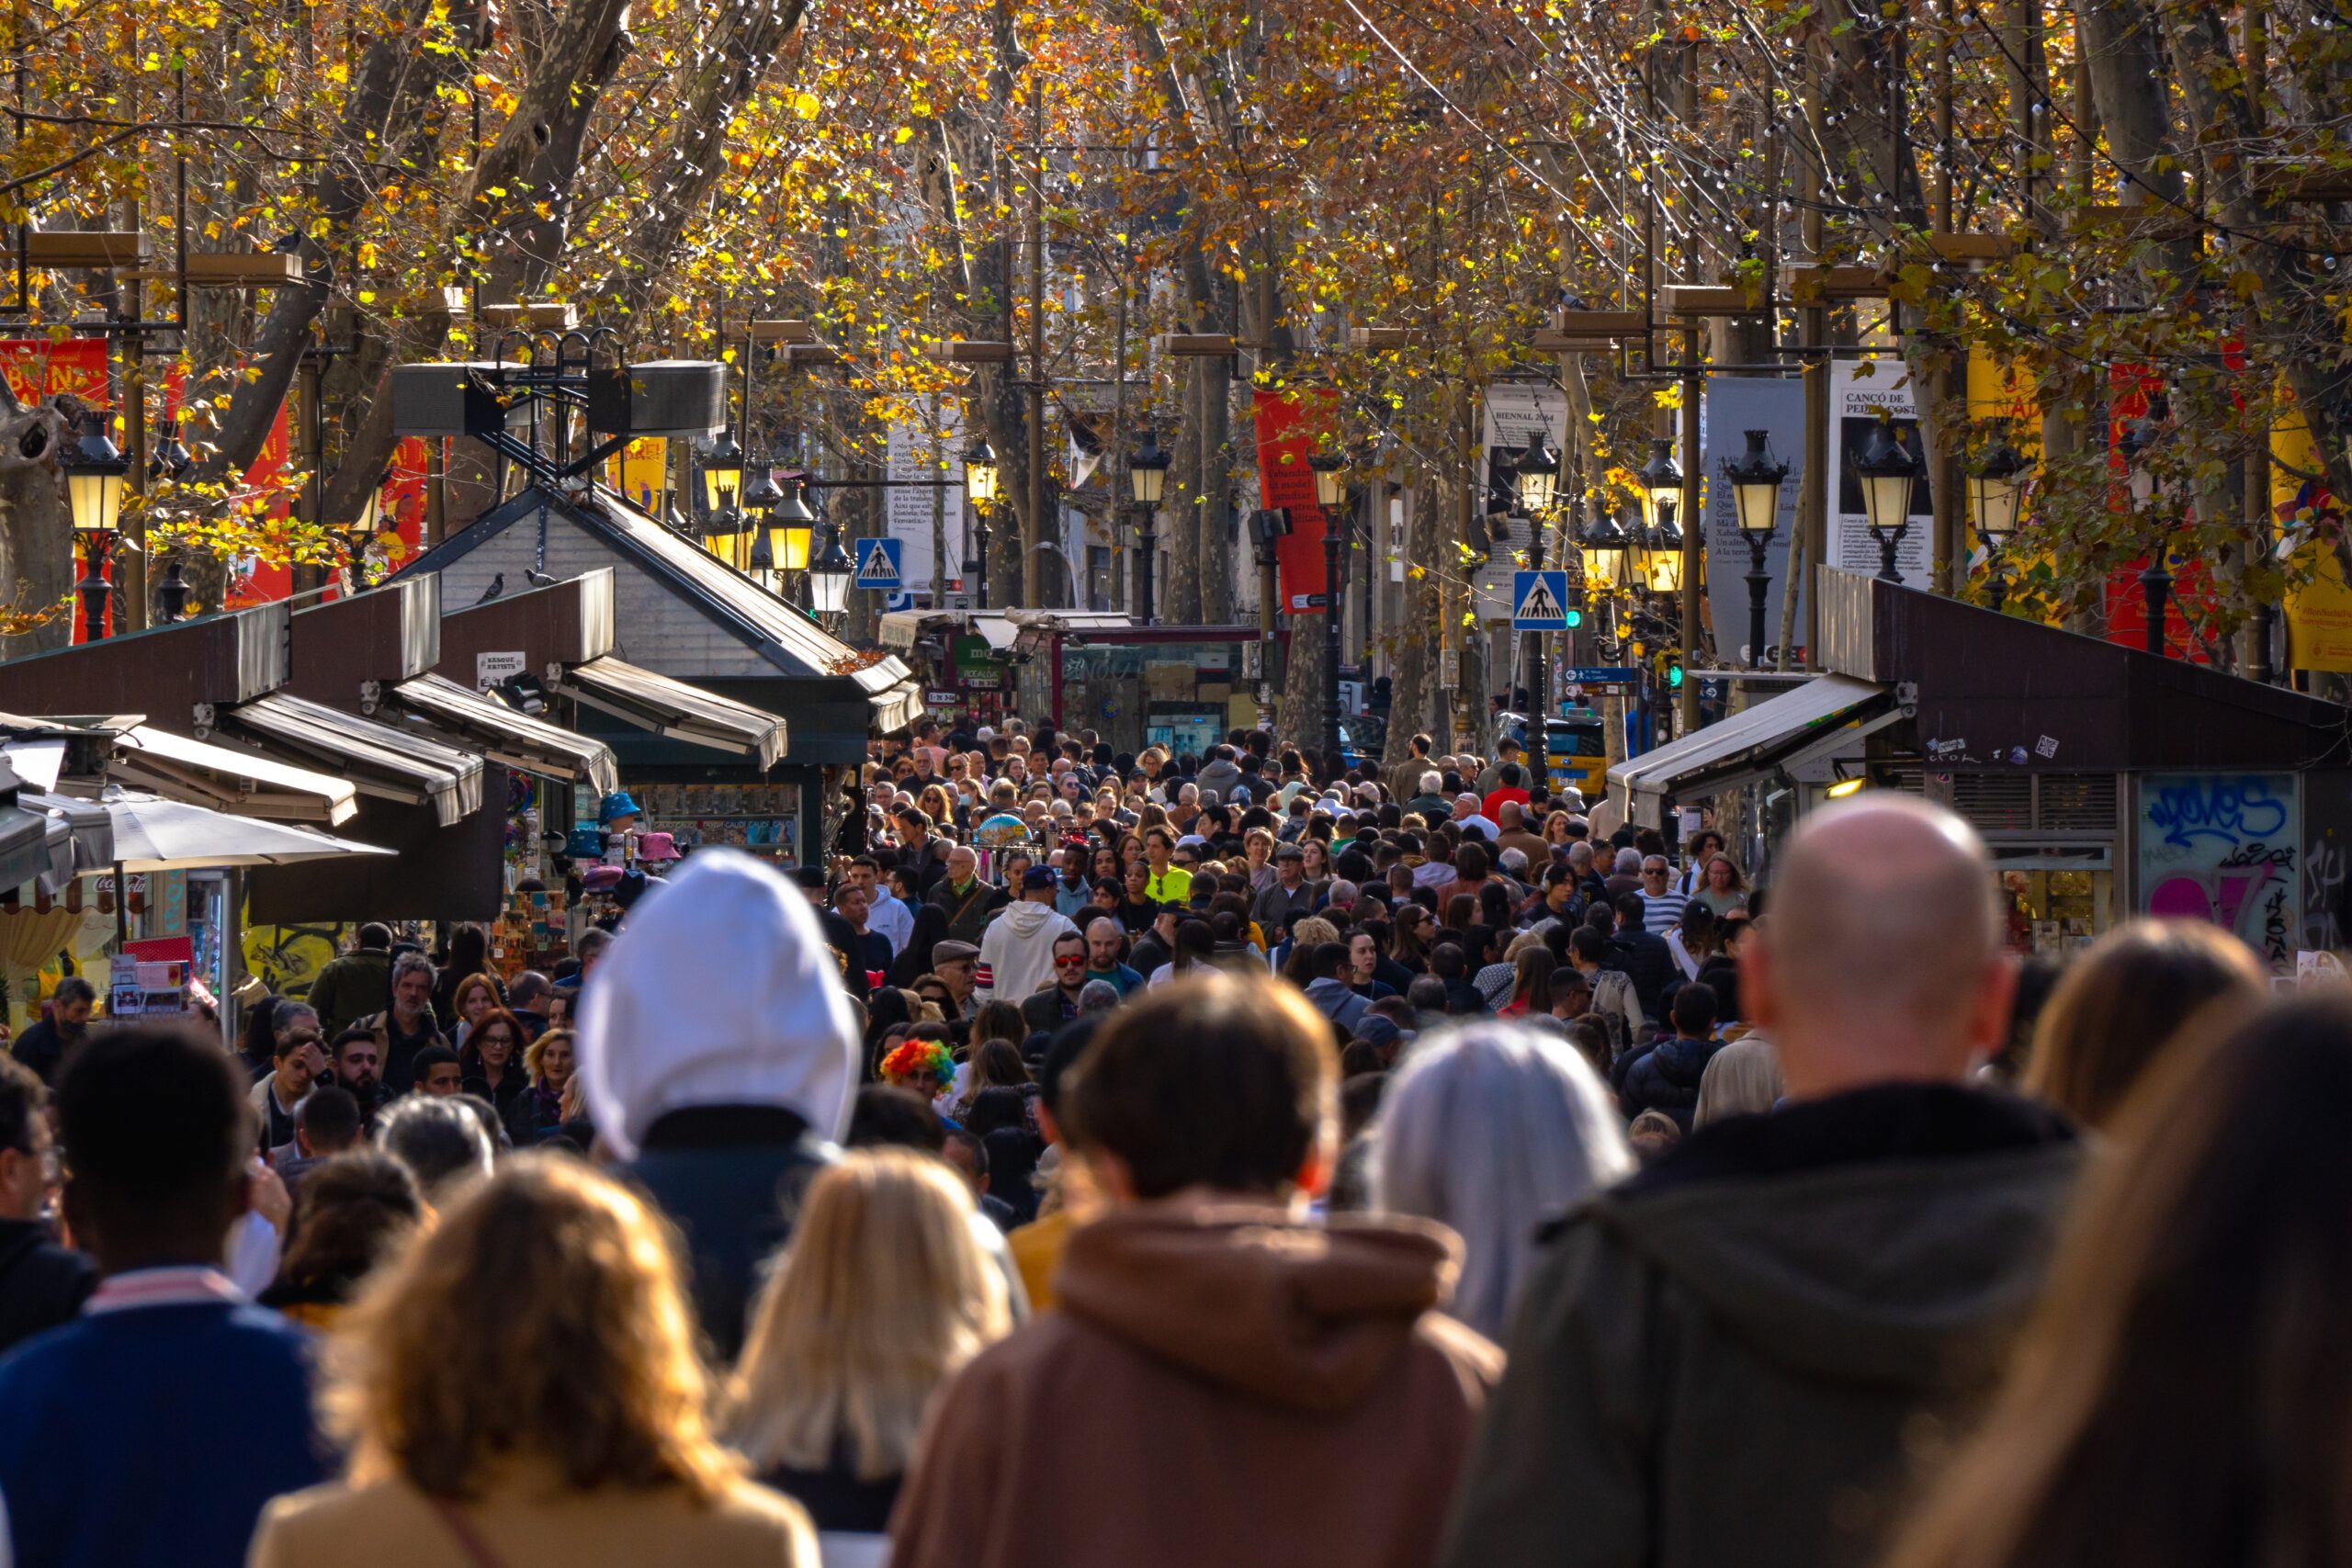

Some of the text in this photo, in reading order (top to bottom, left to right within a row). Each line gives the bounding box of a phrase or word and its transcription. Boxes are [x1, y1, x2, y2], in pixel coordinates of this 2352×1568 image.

[1846, 392, 1905, 404] CANÇÓ DE
[1887, 405, 1917, 414] COST
[1496, 412, 1533, 421] BIENNAL
[93, 874, 148, 893] Cocaola
